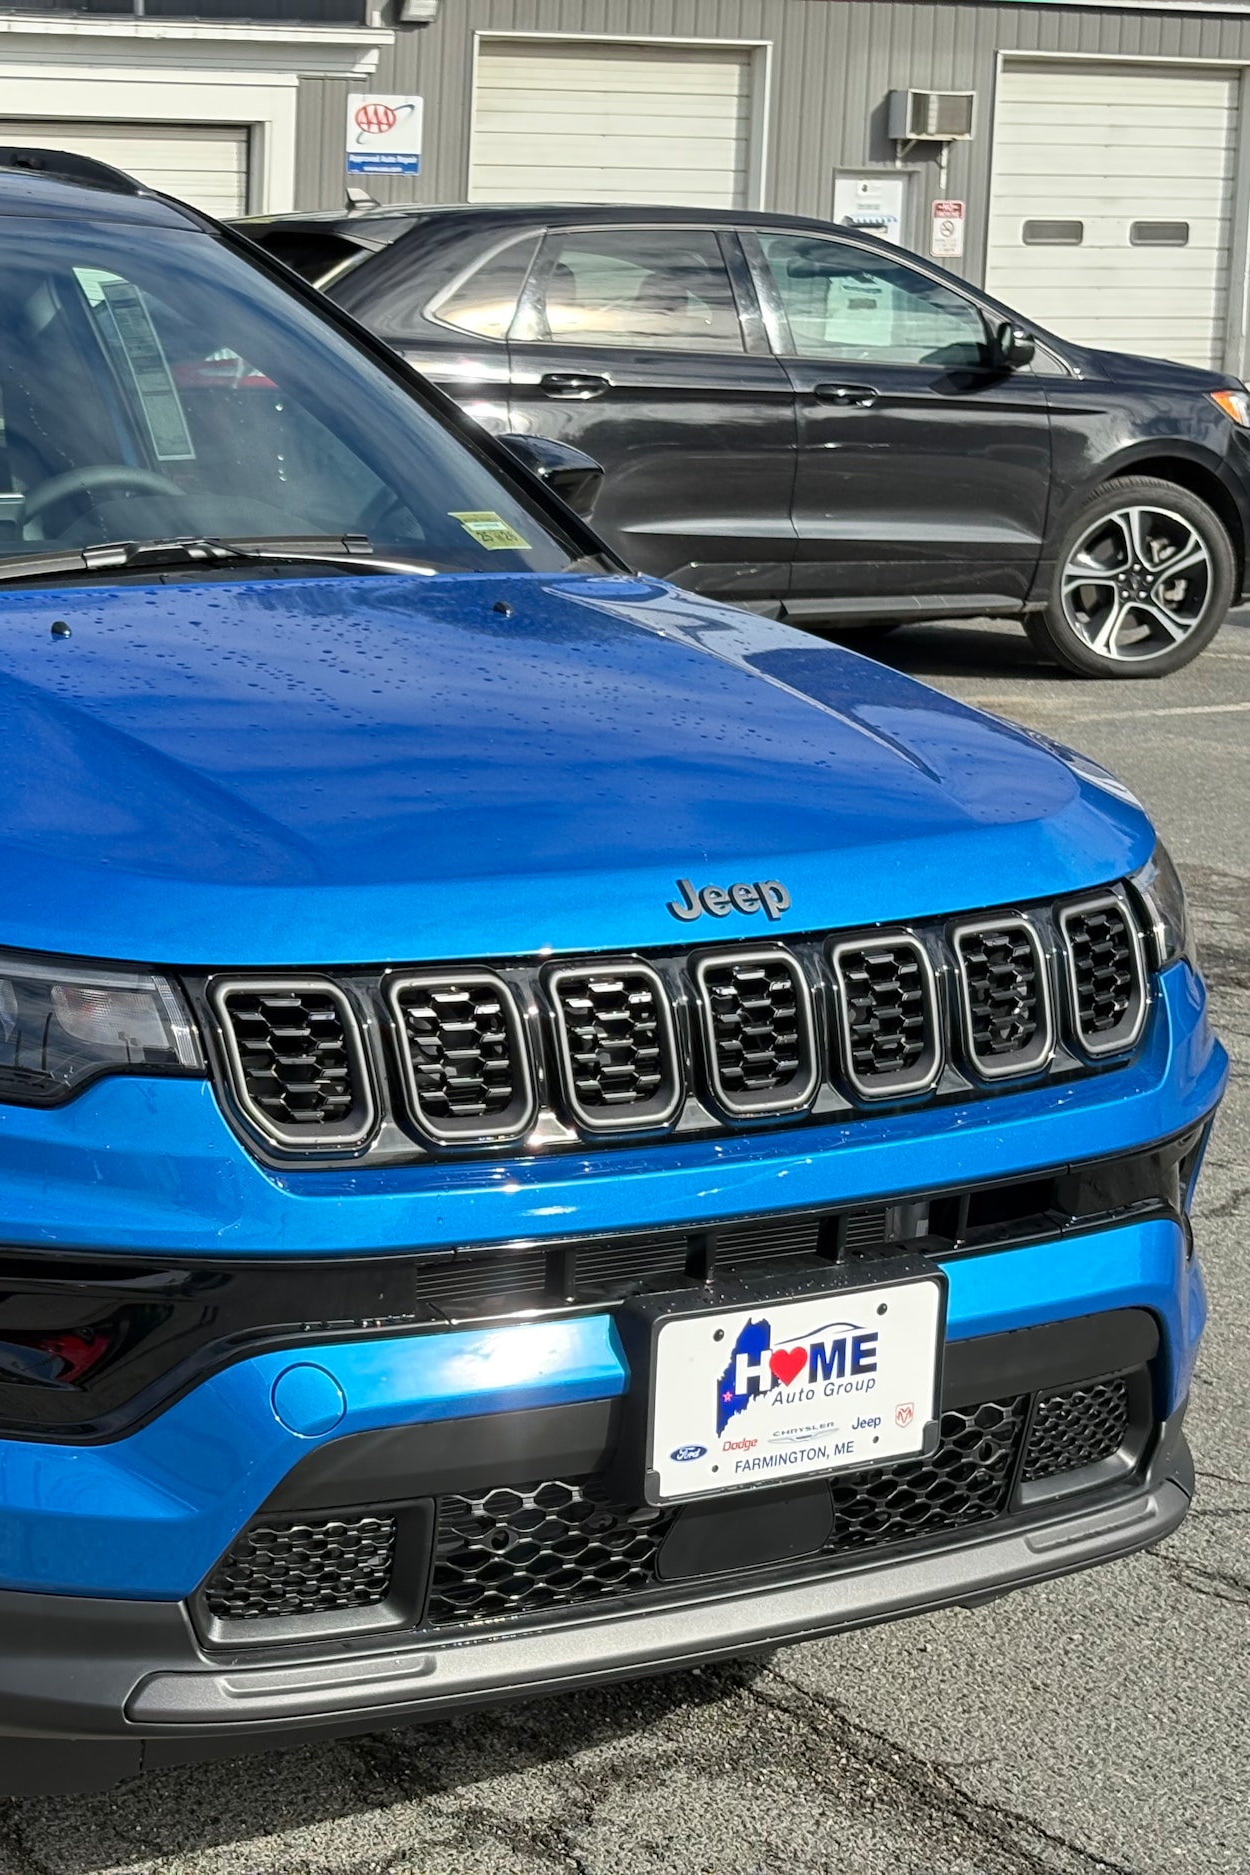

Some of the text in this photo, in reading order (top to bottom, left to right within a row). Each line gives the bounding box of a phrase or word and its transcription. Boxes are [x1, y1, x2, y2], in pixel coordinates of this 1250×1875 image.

[356, 104, 395, 133] AAA
[665, 878, 791, 922] Jeep
[771, 1378, 876, 1406] Auto Group
[772, 1421, 835, 1437] CHRYSLER
[851, 1416, 881, 1431] Jeep
[676, 1446, 702, 1460] Ford
[722, 1437, 758, 1452] Dodge
[734, 1441, 854, 1474] FARMINGTON, ME
